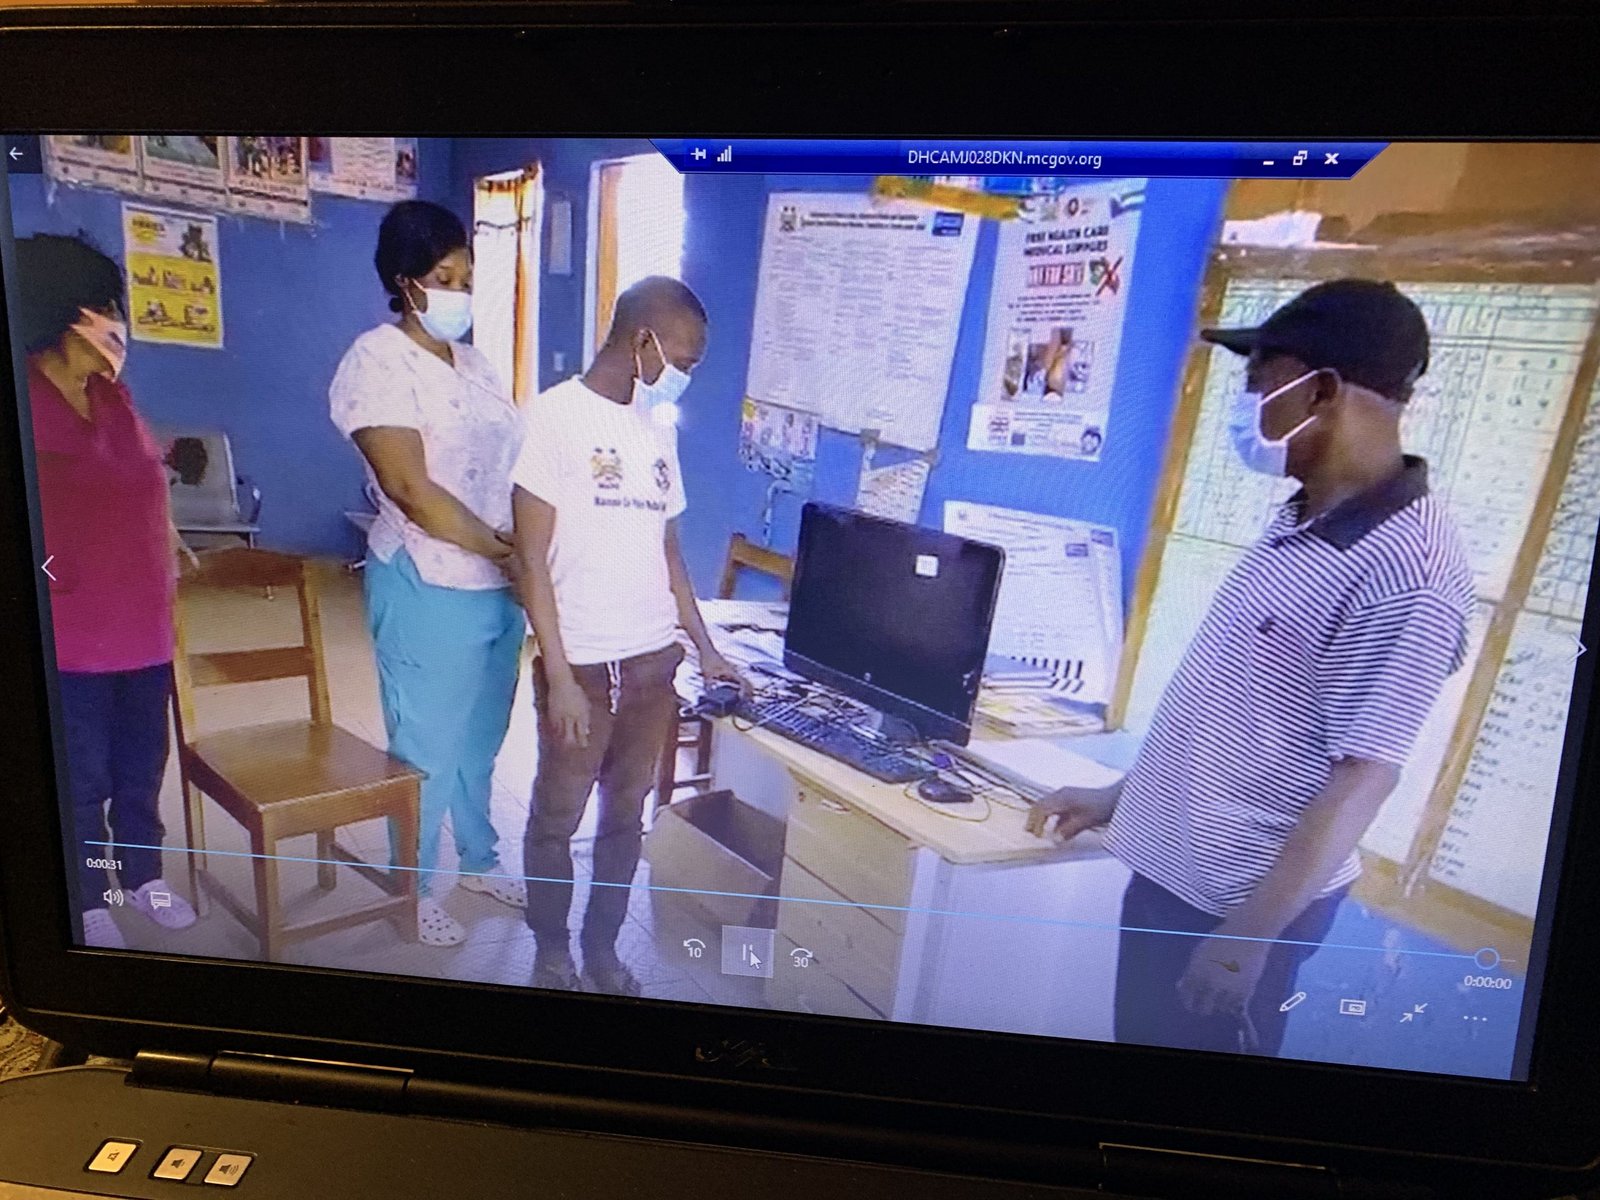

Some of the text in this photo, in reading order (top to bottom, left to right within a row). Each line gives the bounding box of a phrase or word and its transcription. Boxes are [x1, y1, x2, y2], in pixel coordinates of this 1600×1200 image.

[908, 150, 1102, 169] DHCAMJ028DKN.mcgov.org
[86, 857, 122, 870] 0:00:31
[688, 947, 702, 958] 10
[793, 956, 809, 968] 30
[1463, 975, 1513, 989] 0:00:00
